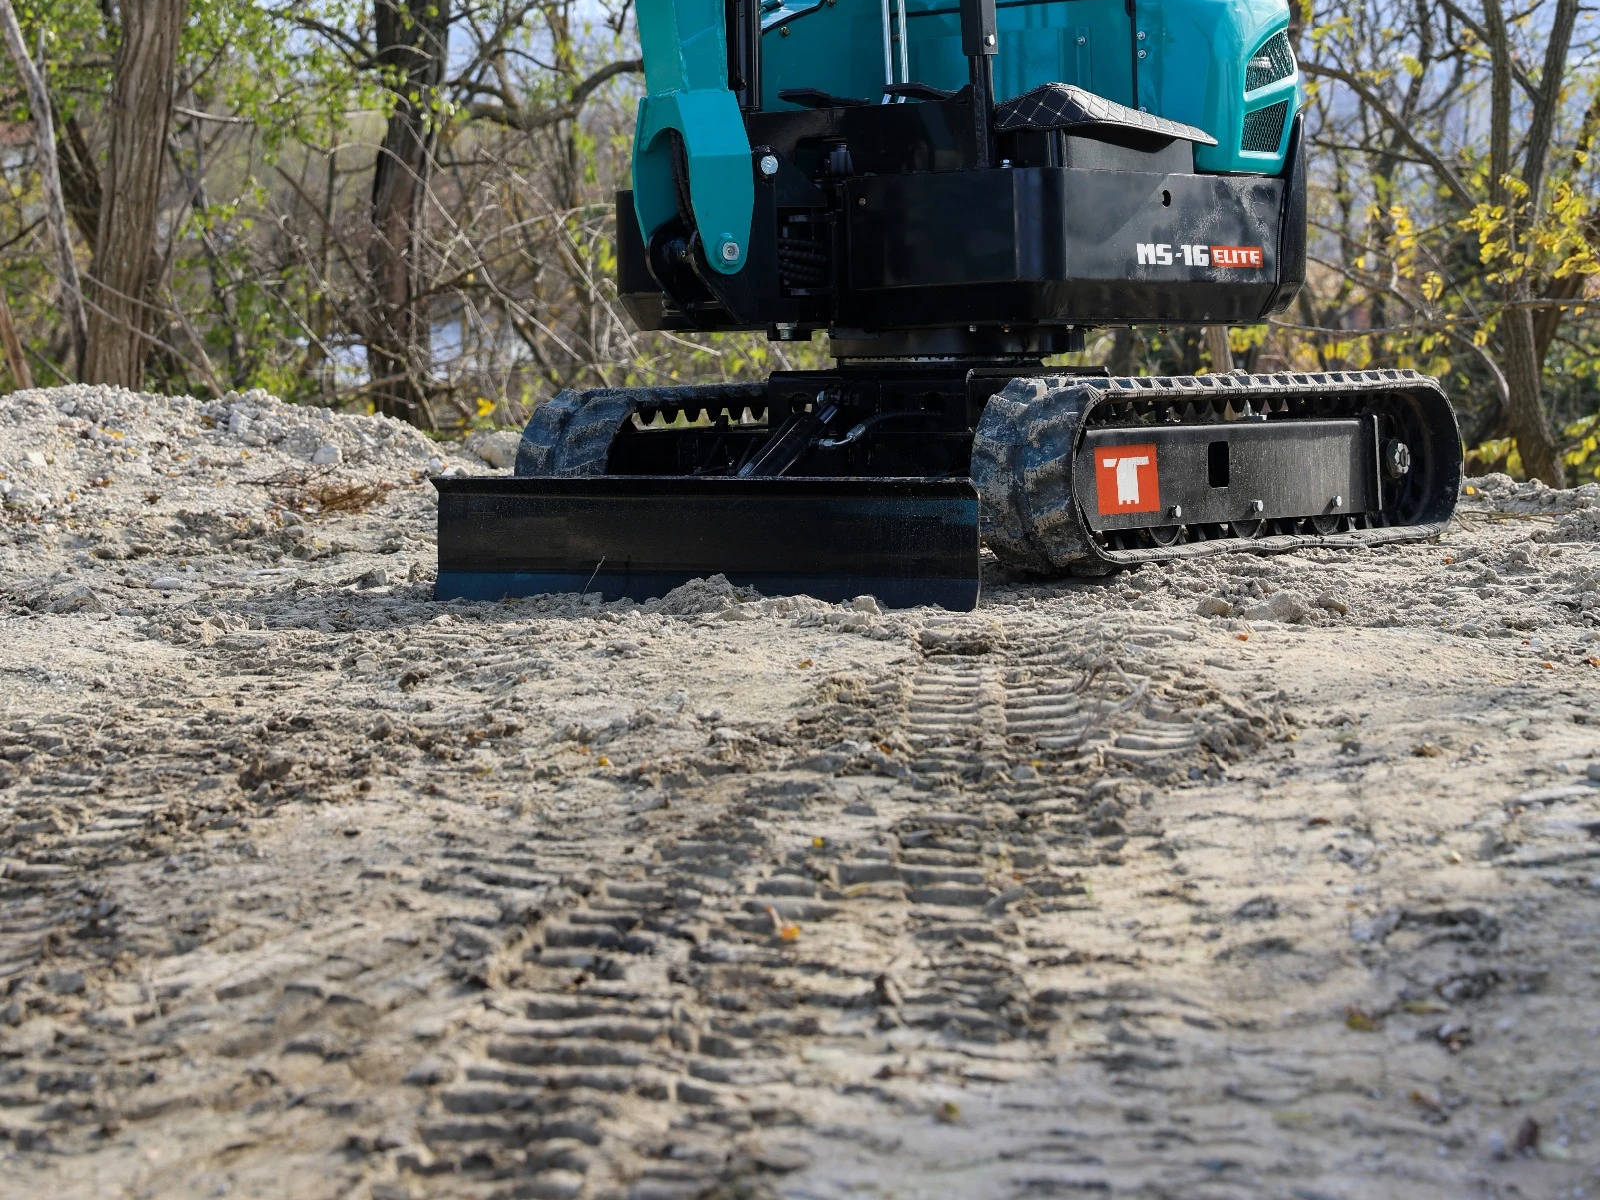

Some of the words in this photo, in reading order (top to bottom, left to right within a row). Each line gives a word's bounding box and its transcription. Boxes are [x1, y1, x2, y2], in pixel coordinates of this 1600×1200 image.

[1136, 243, 1209, 267] MS-16
[1213, 249, 1261, 265] ELITE
[1103, 456, 1150, 505] T
